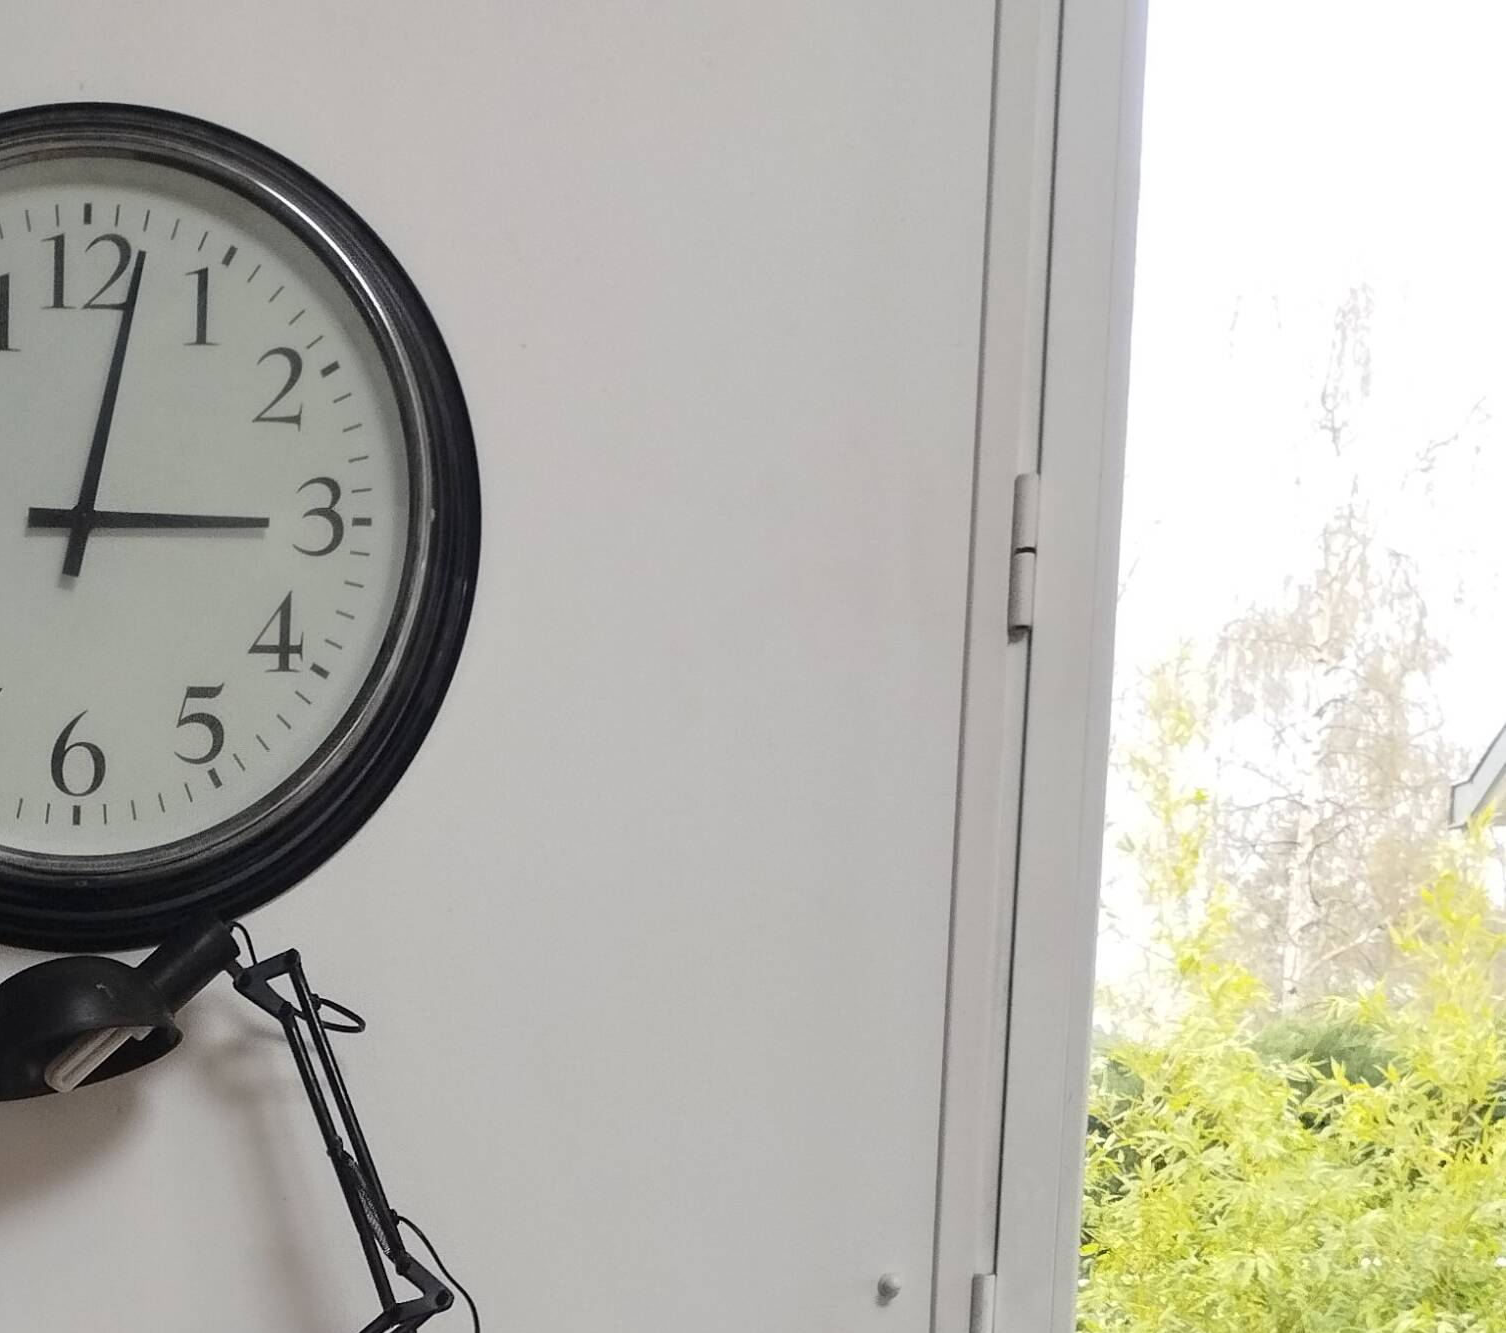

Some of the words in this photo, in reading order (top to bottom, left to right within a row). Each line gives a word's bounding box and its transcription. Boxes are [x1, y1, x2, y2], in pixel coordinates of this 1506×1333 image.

[41, 233, 134, 310] 12
[184, 267, 219, 347] 1
[251, 346, 304, 431] 2
[292, 476, 345, 557] 3
[247, 590, 305, 673] 4
[50, 709, 107, 797] 6
[174, 682, 225, 765] 5
